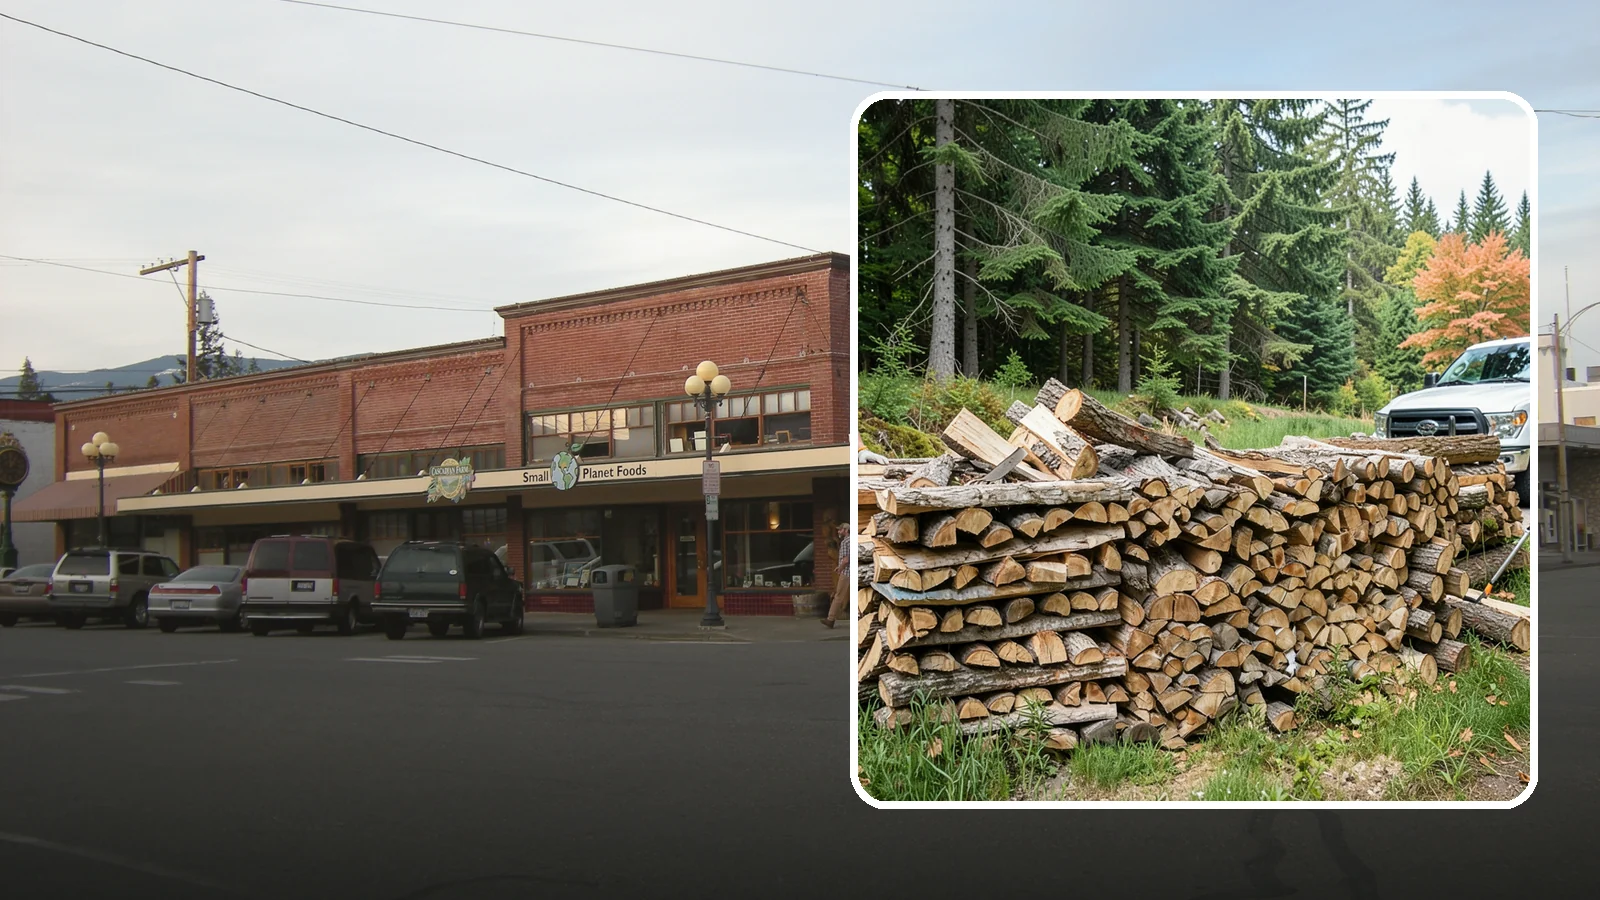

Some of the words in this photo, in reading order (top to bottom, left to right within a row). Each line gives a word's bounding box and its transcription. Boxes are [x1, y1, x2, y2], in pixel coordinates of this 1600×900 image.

[431, 466, 456, 475] CASCADIAN
[456, 465, 469, 474] FARM
[523, 471, 549, 483] Small
[583, 467, 614, 479] Planet
[617, 464, 647, 477] Foods
